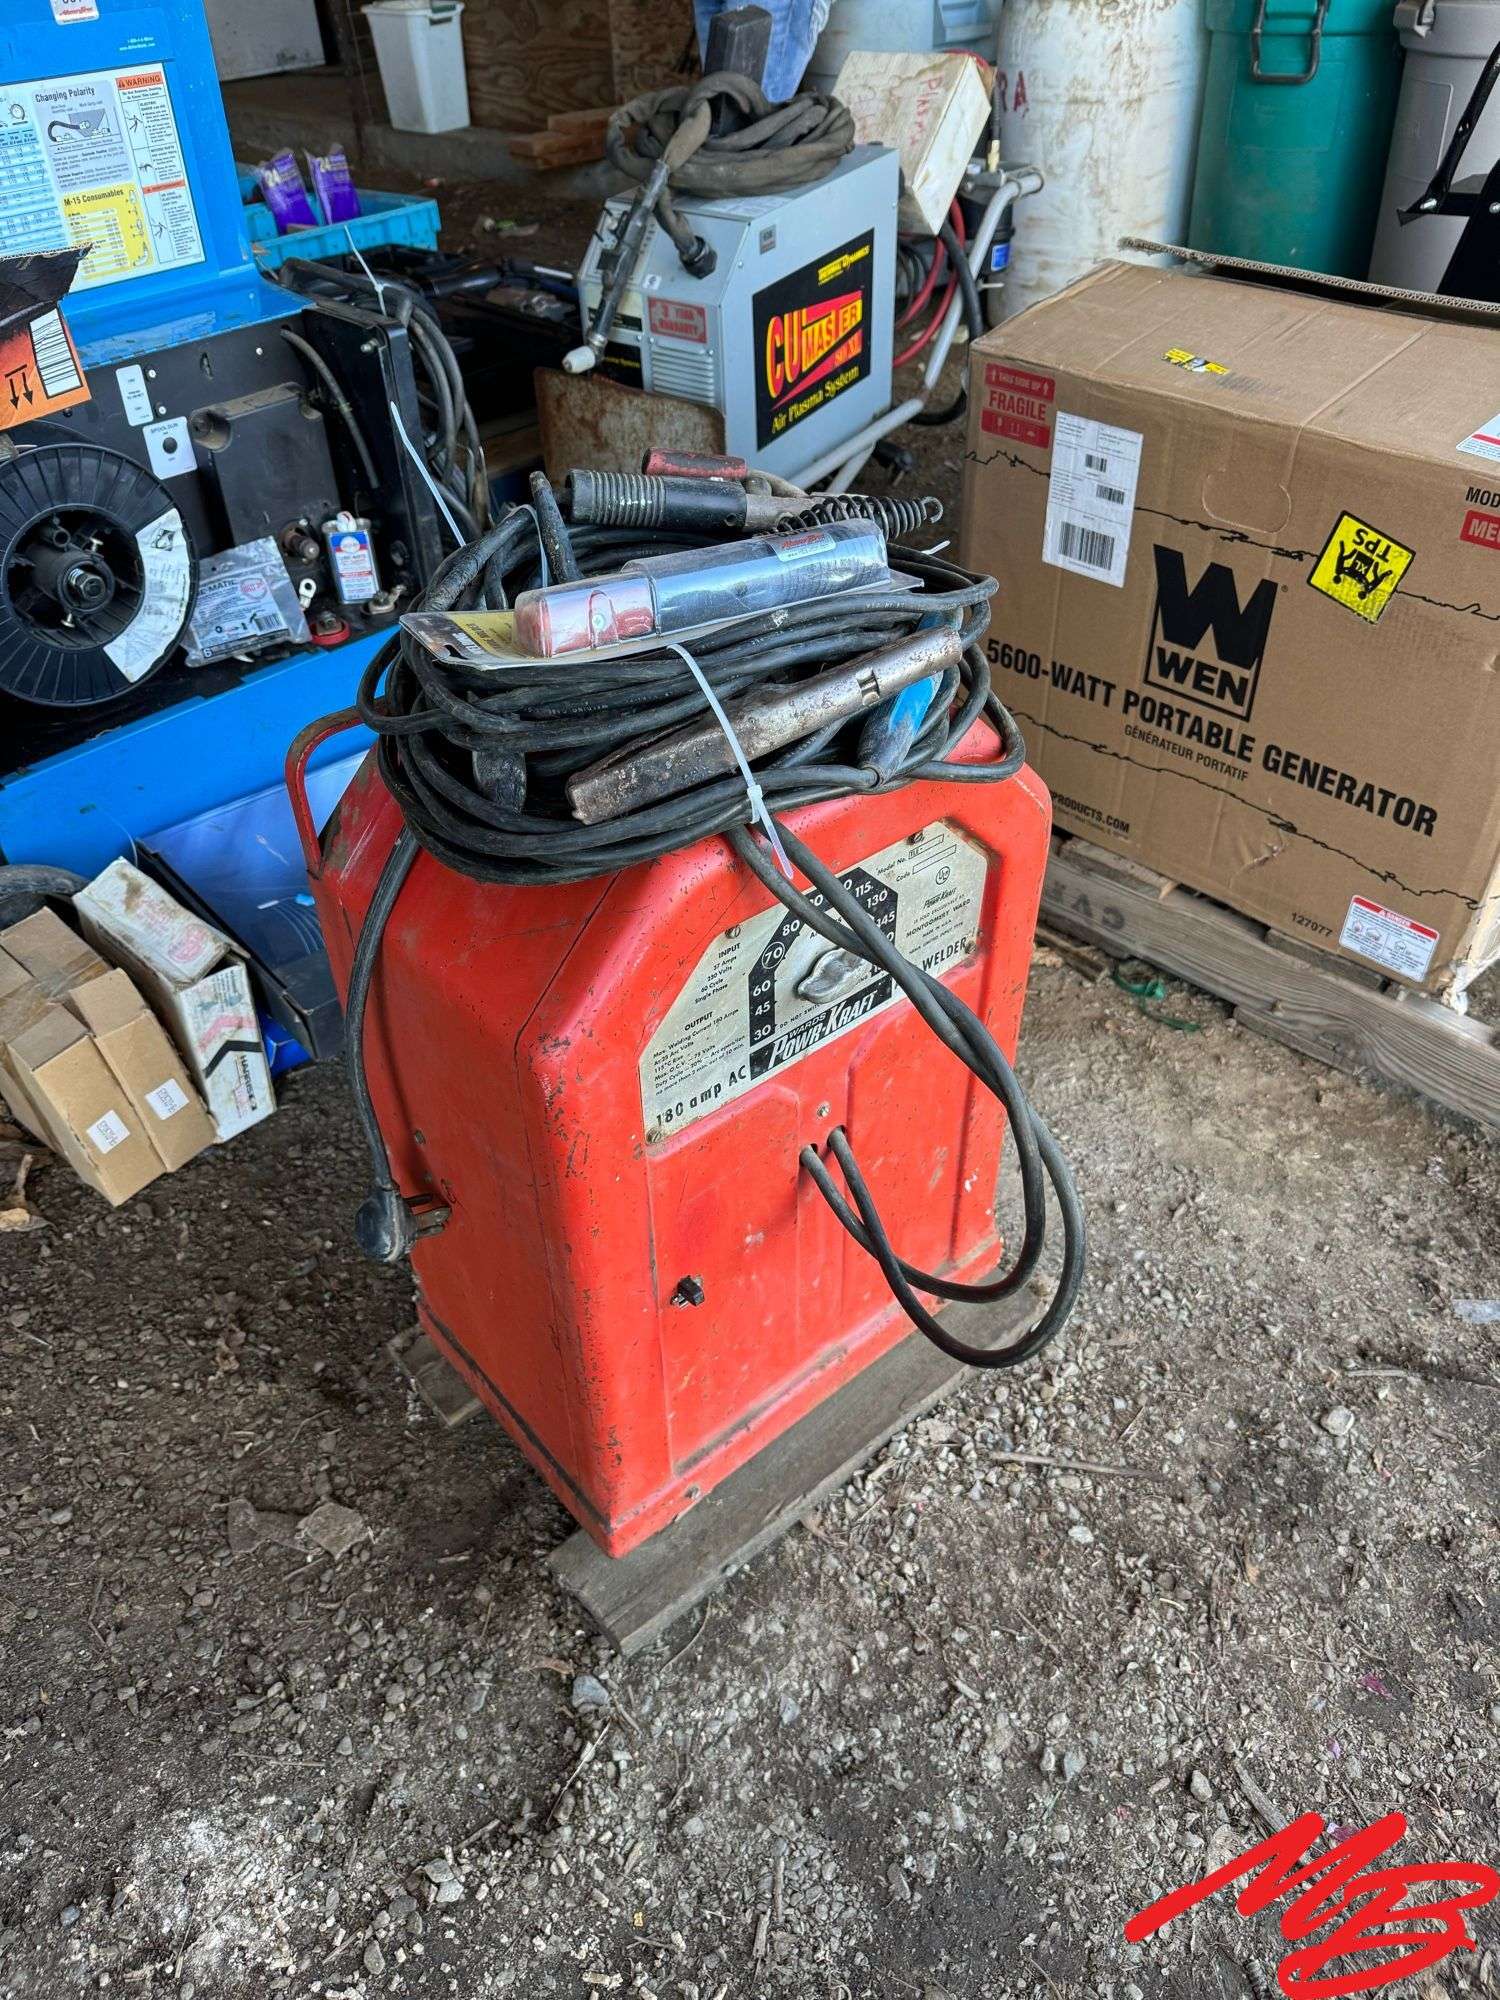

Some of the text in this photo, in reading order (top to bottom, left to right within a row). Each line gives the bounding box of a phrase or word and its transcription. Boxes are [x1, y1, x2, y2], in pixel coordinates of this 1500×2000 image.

[126, 74, 160, 87] WARNING
[35, 86, 96, 103] Changing Polarity
[264, 167, 281, 188] 24
[63, 188, 124, 206] M-15 Consumables
[772, 364, 860, 434] Air Plasma System
[989, 390, 1047, 420] FRAGILE
[1468, 518, 1500, 543] ME
[1352, 528, 1393, 564] TPS
[1155, 646, 1250, 707] WEN
[986, 638, 1438, 837] 5600-WATT PORTABLE GENERATOR
[1124, 722, 1250, 782] GÉNÉRATEUR PORTATIF
[877, 862, 896, 876] Model
[896, 856, 907, 865] No.
[896, 872, 911, 882] Code
[854, 881, 872, 898] 115
[866, 889, 888, 909] 130
[906, 898, 971, 938] MONTGOMERY WARD
[1290, 912, 1333, 938] 127077
[782, 920, 800, 937] 80
[718, 943, 741, 958] INPUT
[764, 947, 783, 964] 70
[922, 936, 967, 971] WELDER
[718, 966, 732, 975] Volts
[722, 956, 737, 966] Amps
[710, 978, 724, 989] Cycle
[752, 980, 771, 997] 60
[695, 984, 728, 1004] Single Phase
[754, 1000, 771, 1016] 45
[684, 1012, 713, 1030] OUTPUT
[780, 1020, 788, 1028] DO
[790, 1012, 802, 1022] NOT
[789, 1012, 827, 1039] WARDS
[668, 1035, 691, 1050] Welding
[692, 1023, 712, 1037] Current
[713, 1016, 723, 1025] 180
[753, 1024, 772, 1041] 30
[768, 990, 878, 1070] POWR-KRAFT
[670, 1050, 680, 1058] Arc
[680, 1041, 694, 1051] Volts
[702, 1044, 716, 1054] Volts
[656, 1080, 668, 1089] Duty
[669, 1070, 684, 1081] Cycle
[710, 1049, 720, 1058] Arc
[720, 1036, 745, 1050] operation
[664, 1081, 678, 1091] more
[678, 1074, 691, 1083] than
[656, 1064, 747, 1126] 180 amp AC
